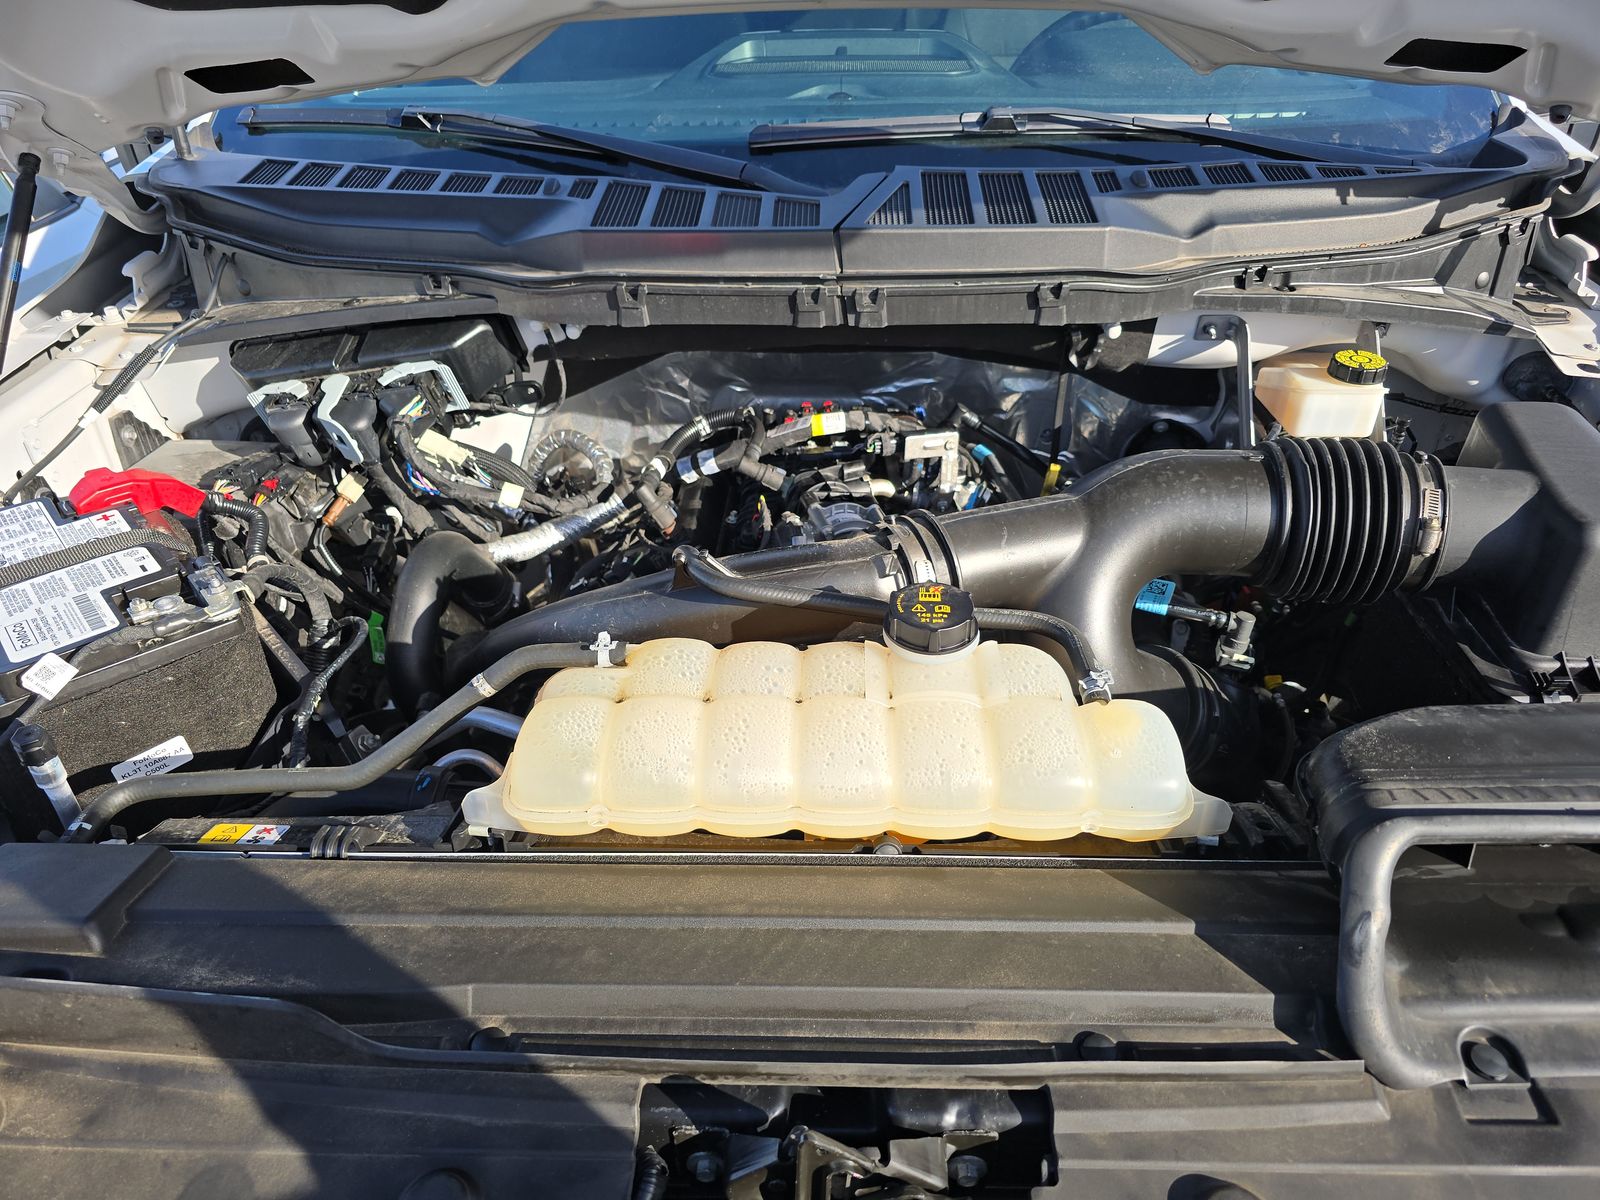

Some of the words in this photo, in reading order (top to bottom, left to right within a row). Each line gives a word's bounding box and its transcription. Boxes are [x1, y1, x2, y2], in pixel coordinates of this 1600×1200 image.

[13, 622, 34, 649] FoMoCo
[121, 766, 143, 780] KL3T
[174, 746, 185, 755] AA
[133, 747, 167, 767] FoMoCo
[145, 763, 170, 776] C500L
